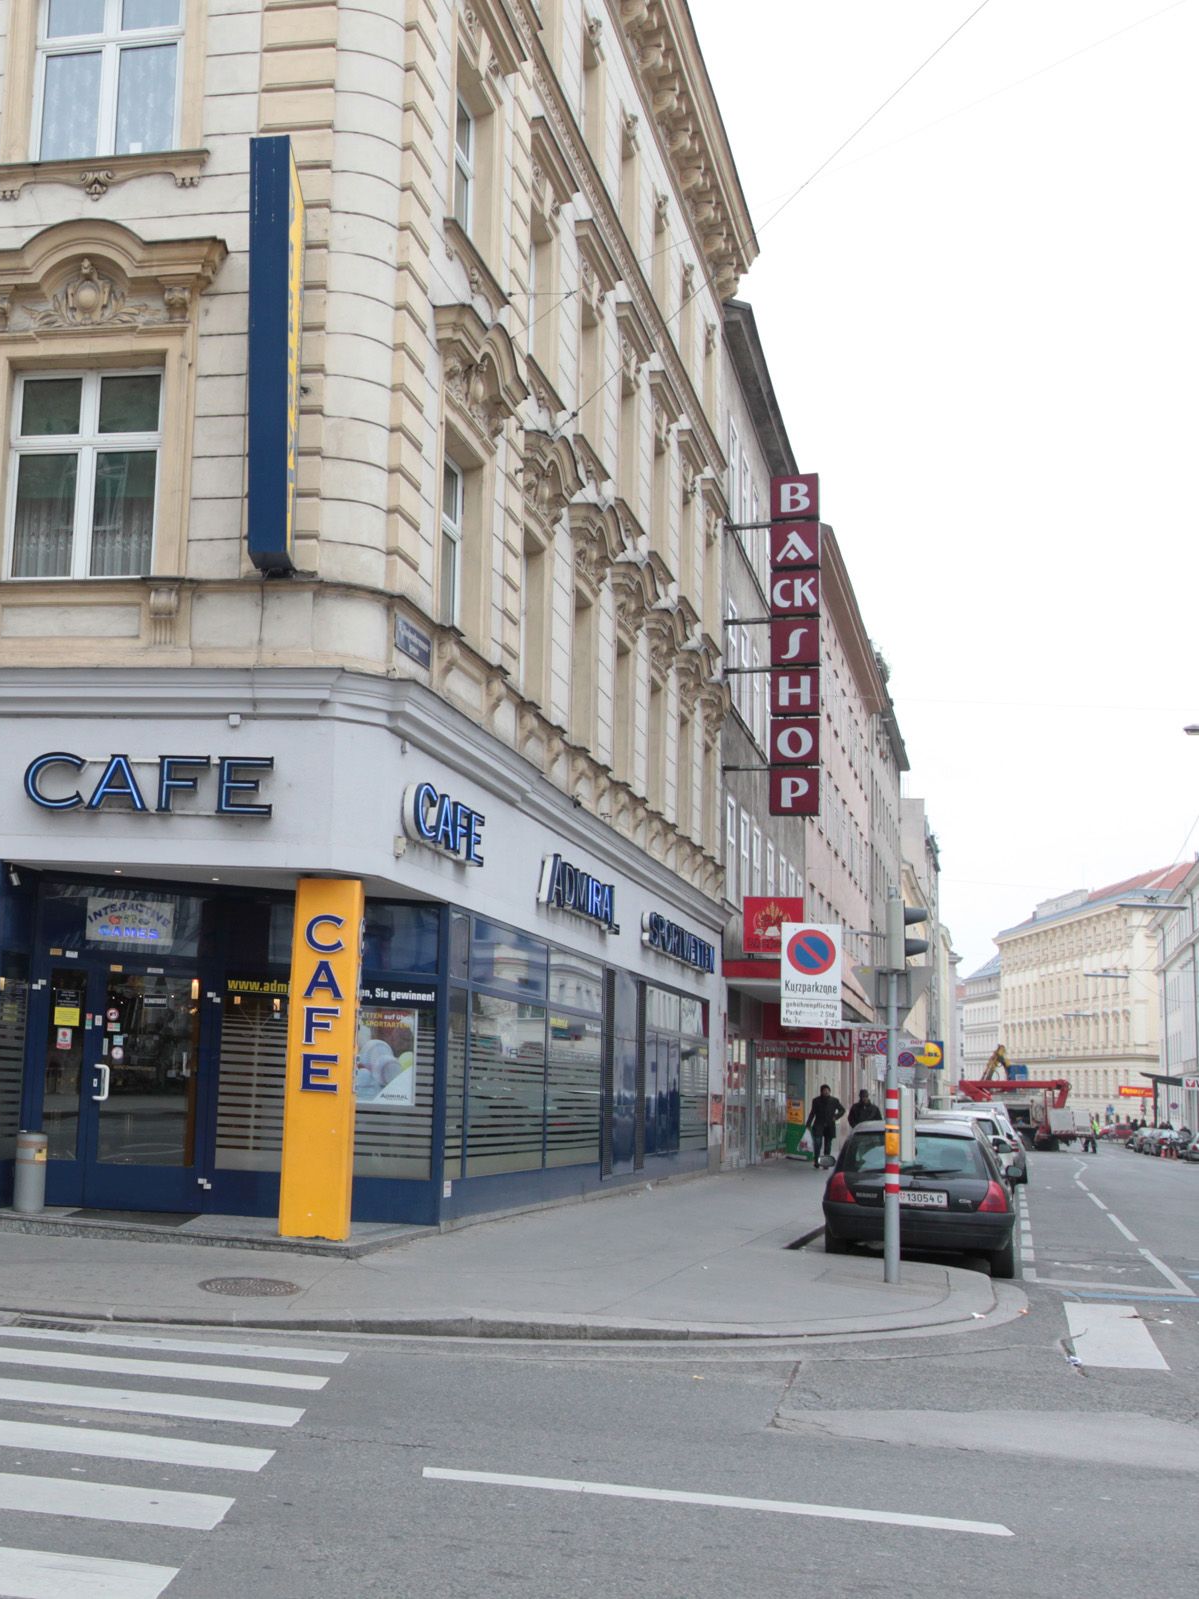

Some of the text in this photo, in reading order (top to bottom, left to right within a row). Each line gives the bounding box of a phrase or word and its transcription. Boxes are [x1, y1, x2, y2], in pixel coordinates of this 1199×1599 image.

[23, 751, 275, 817] CAFE
[413, 783, 485, 867] CAFE
[546, 853, 620, 935] ADMIRAL
[227, 979, 290, 995] www.admi
[299, 914, 345, 1095] CAFE
[375, 987, 389, 998] Sie
[391, 989, 435, 1002] gewinnen!
[784, 980, 838, 995] Kurzparkzone
[906, 1191, 944, 1204] 13054 C
